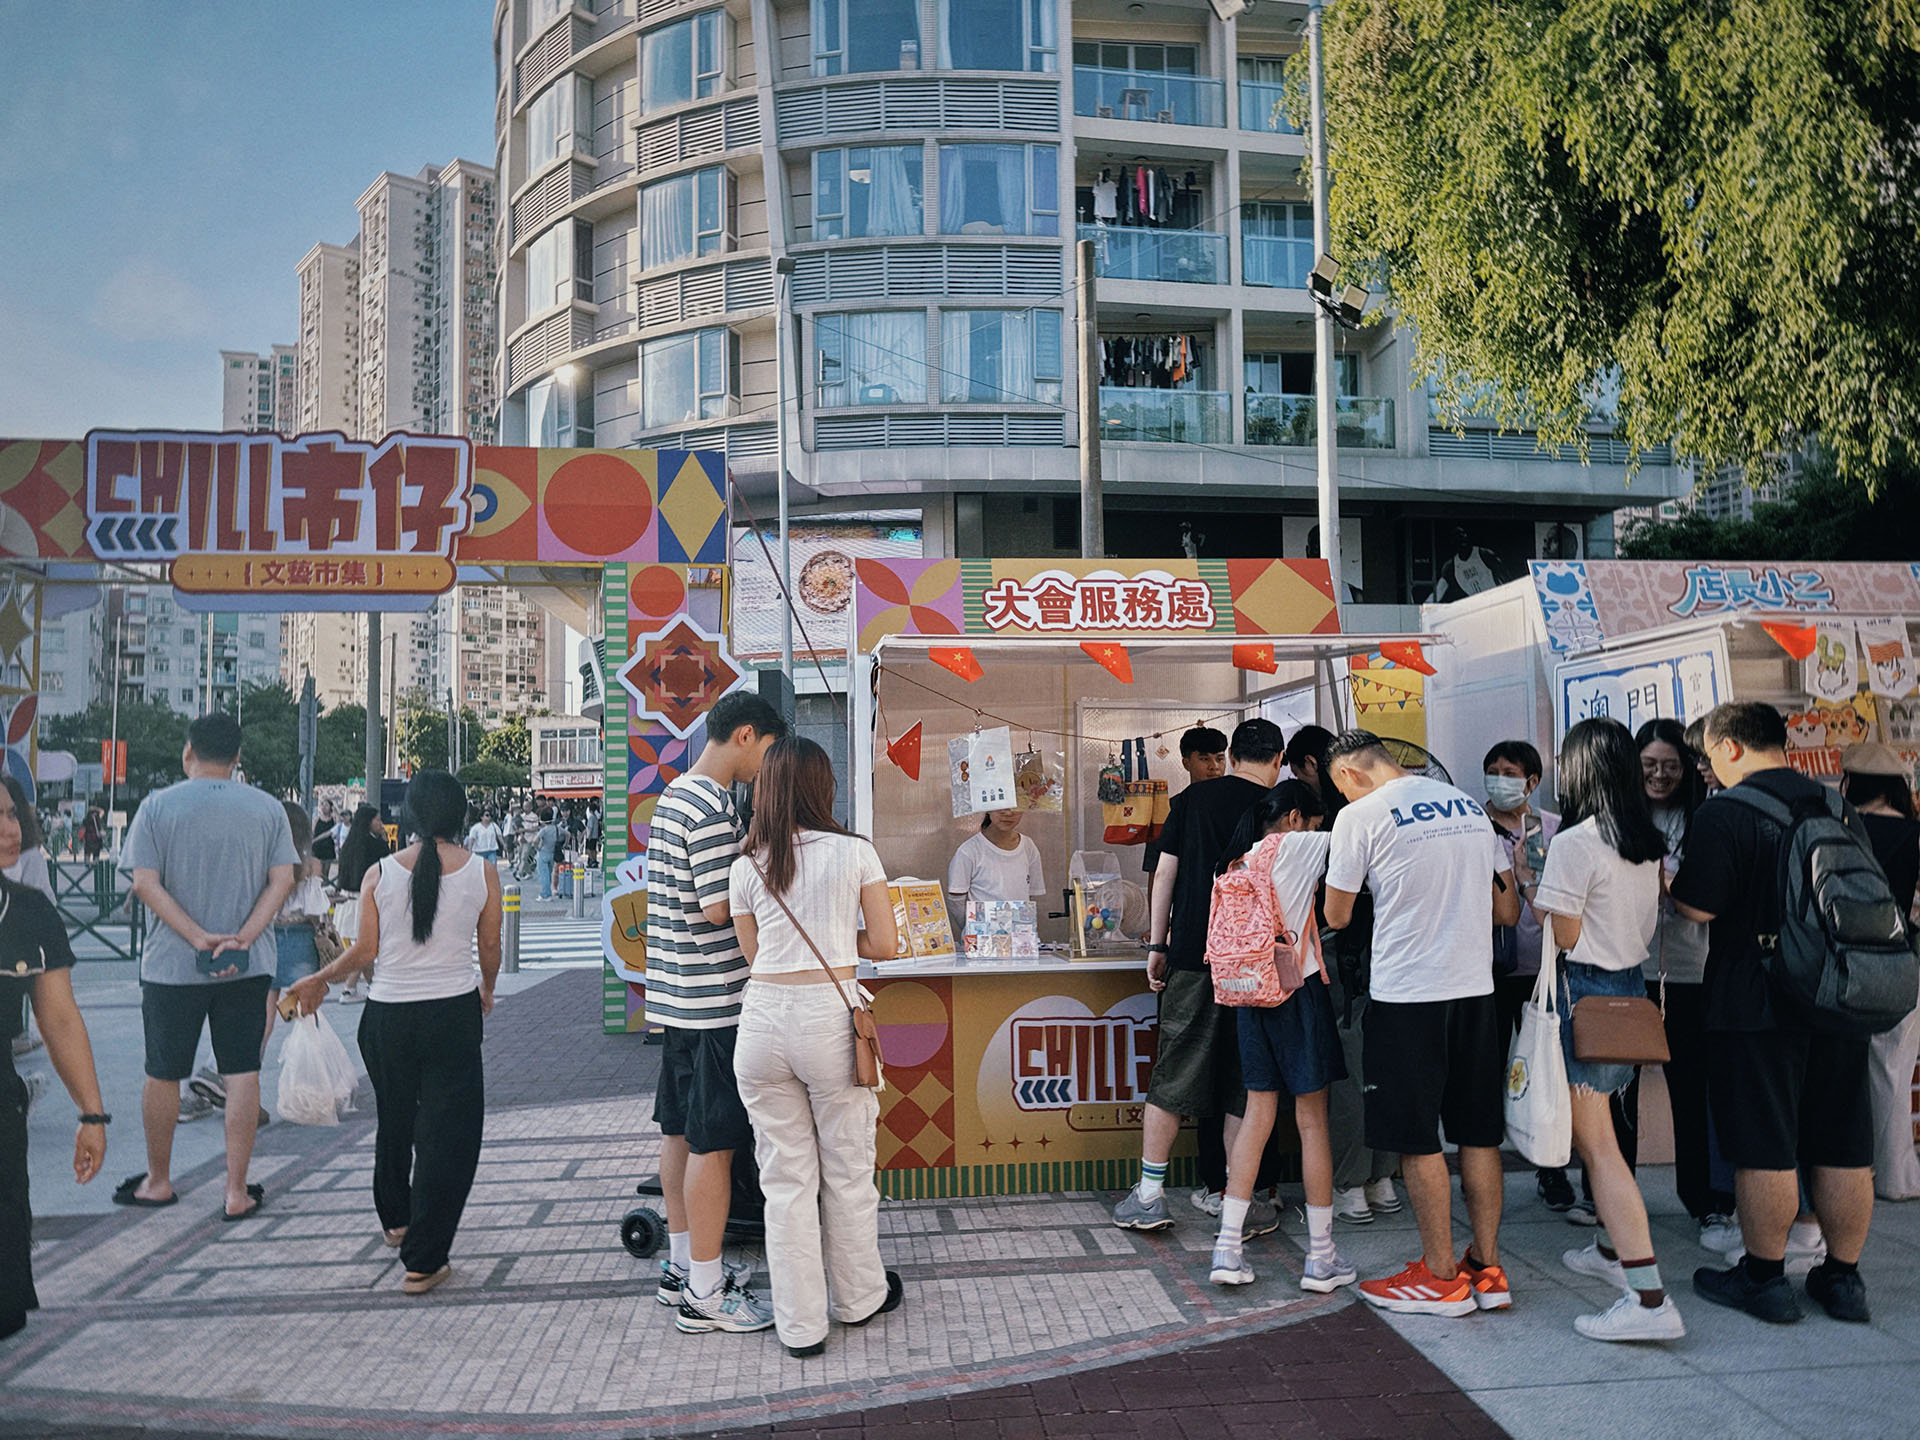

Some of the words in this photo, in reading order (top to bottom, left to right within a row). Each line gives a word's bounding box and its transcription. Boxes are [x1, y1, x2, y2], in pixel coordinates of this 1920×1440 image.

[989, 584, 1210, 625] 大會服務處
